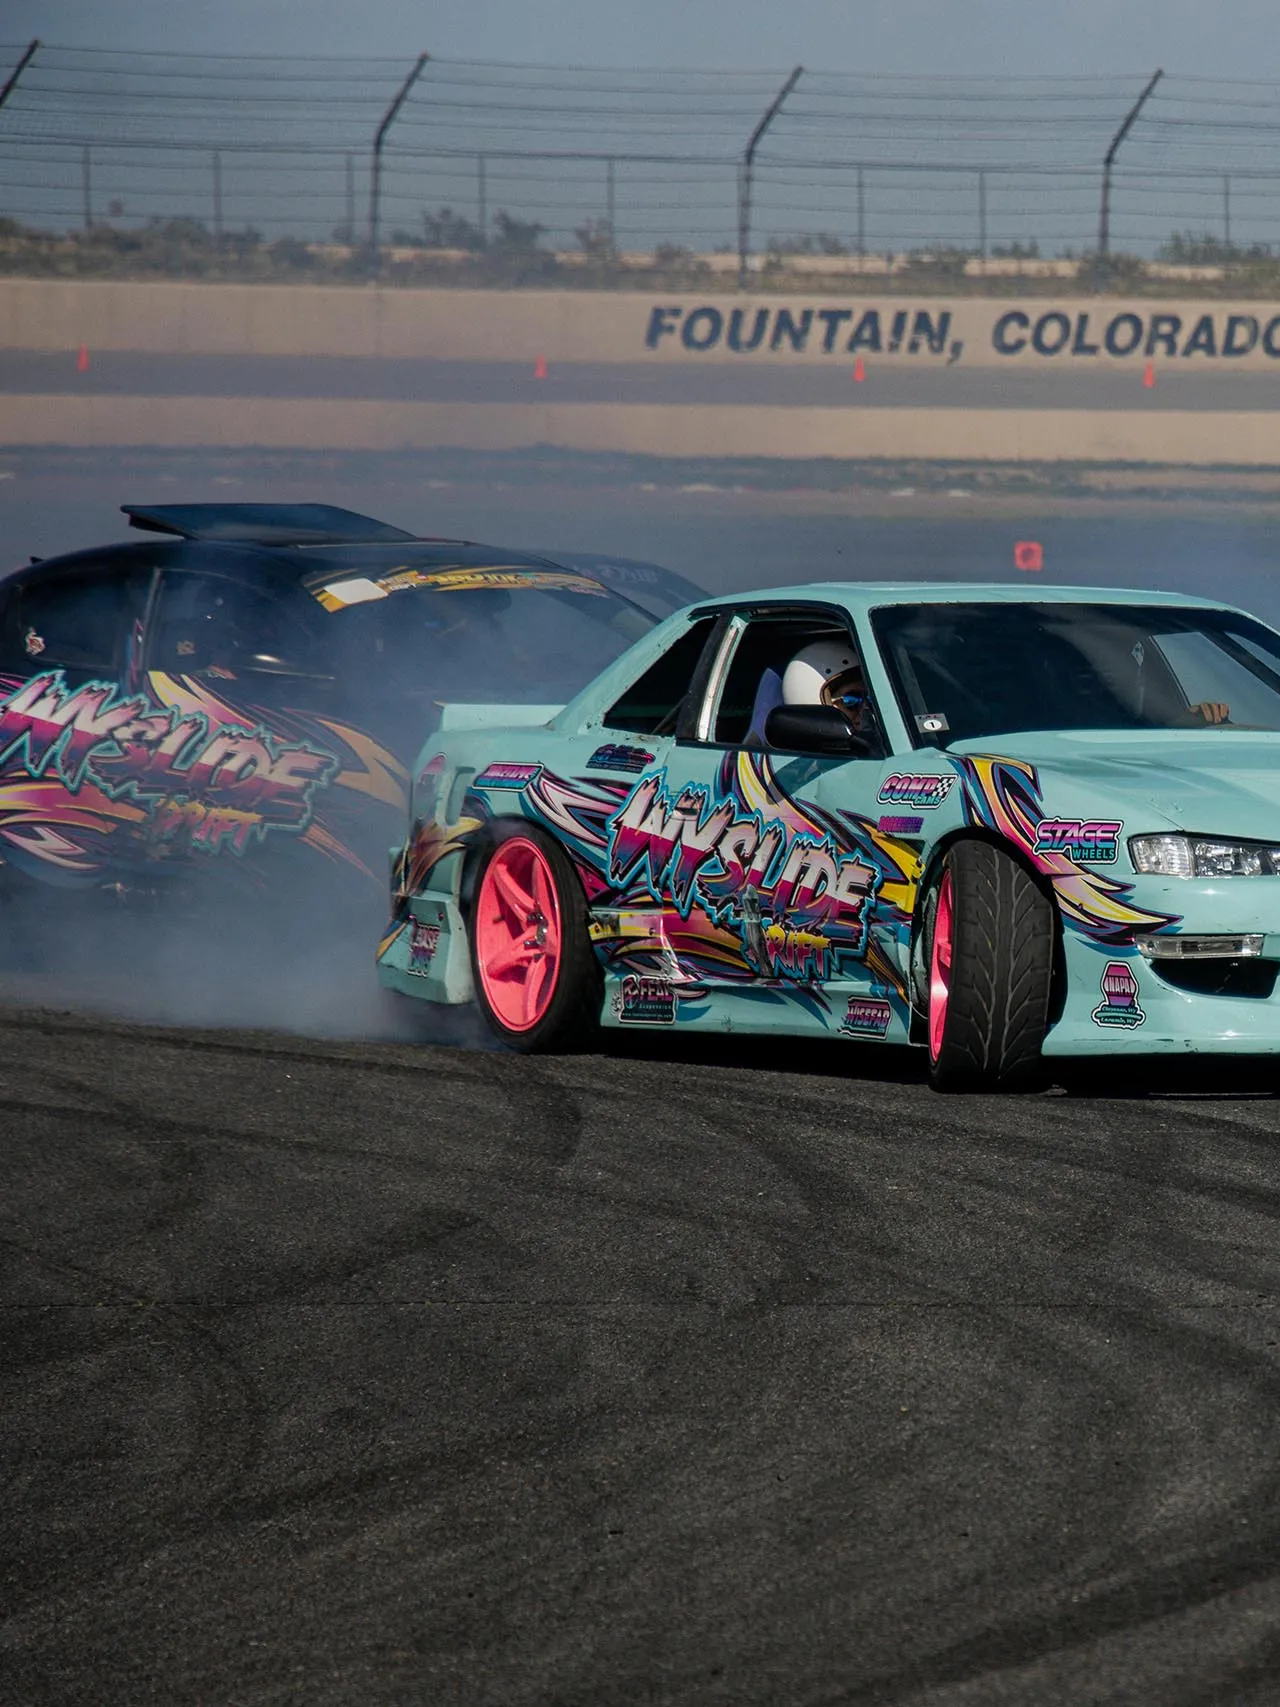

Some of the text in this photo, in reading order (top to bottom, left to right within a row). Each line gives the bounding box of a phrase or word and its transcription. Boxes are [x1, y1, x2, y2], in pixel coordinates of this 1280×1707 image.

[645, 306, 964, 366] FOUNTAIN,
[879, 775, 940, 800] COMP
[913, 795, 942, 805] CAMS
[1036, 821, 1121, 849] STAGE
[1073, 849, 1115, 859] WHEELS
[747, 921, 832, 977] RIFT
